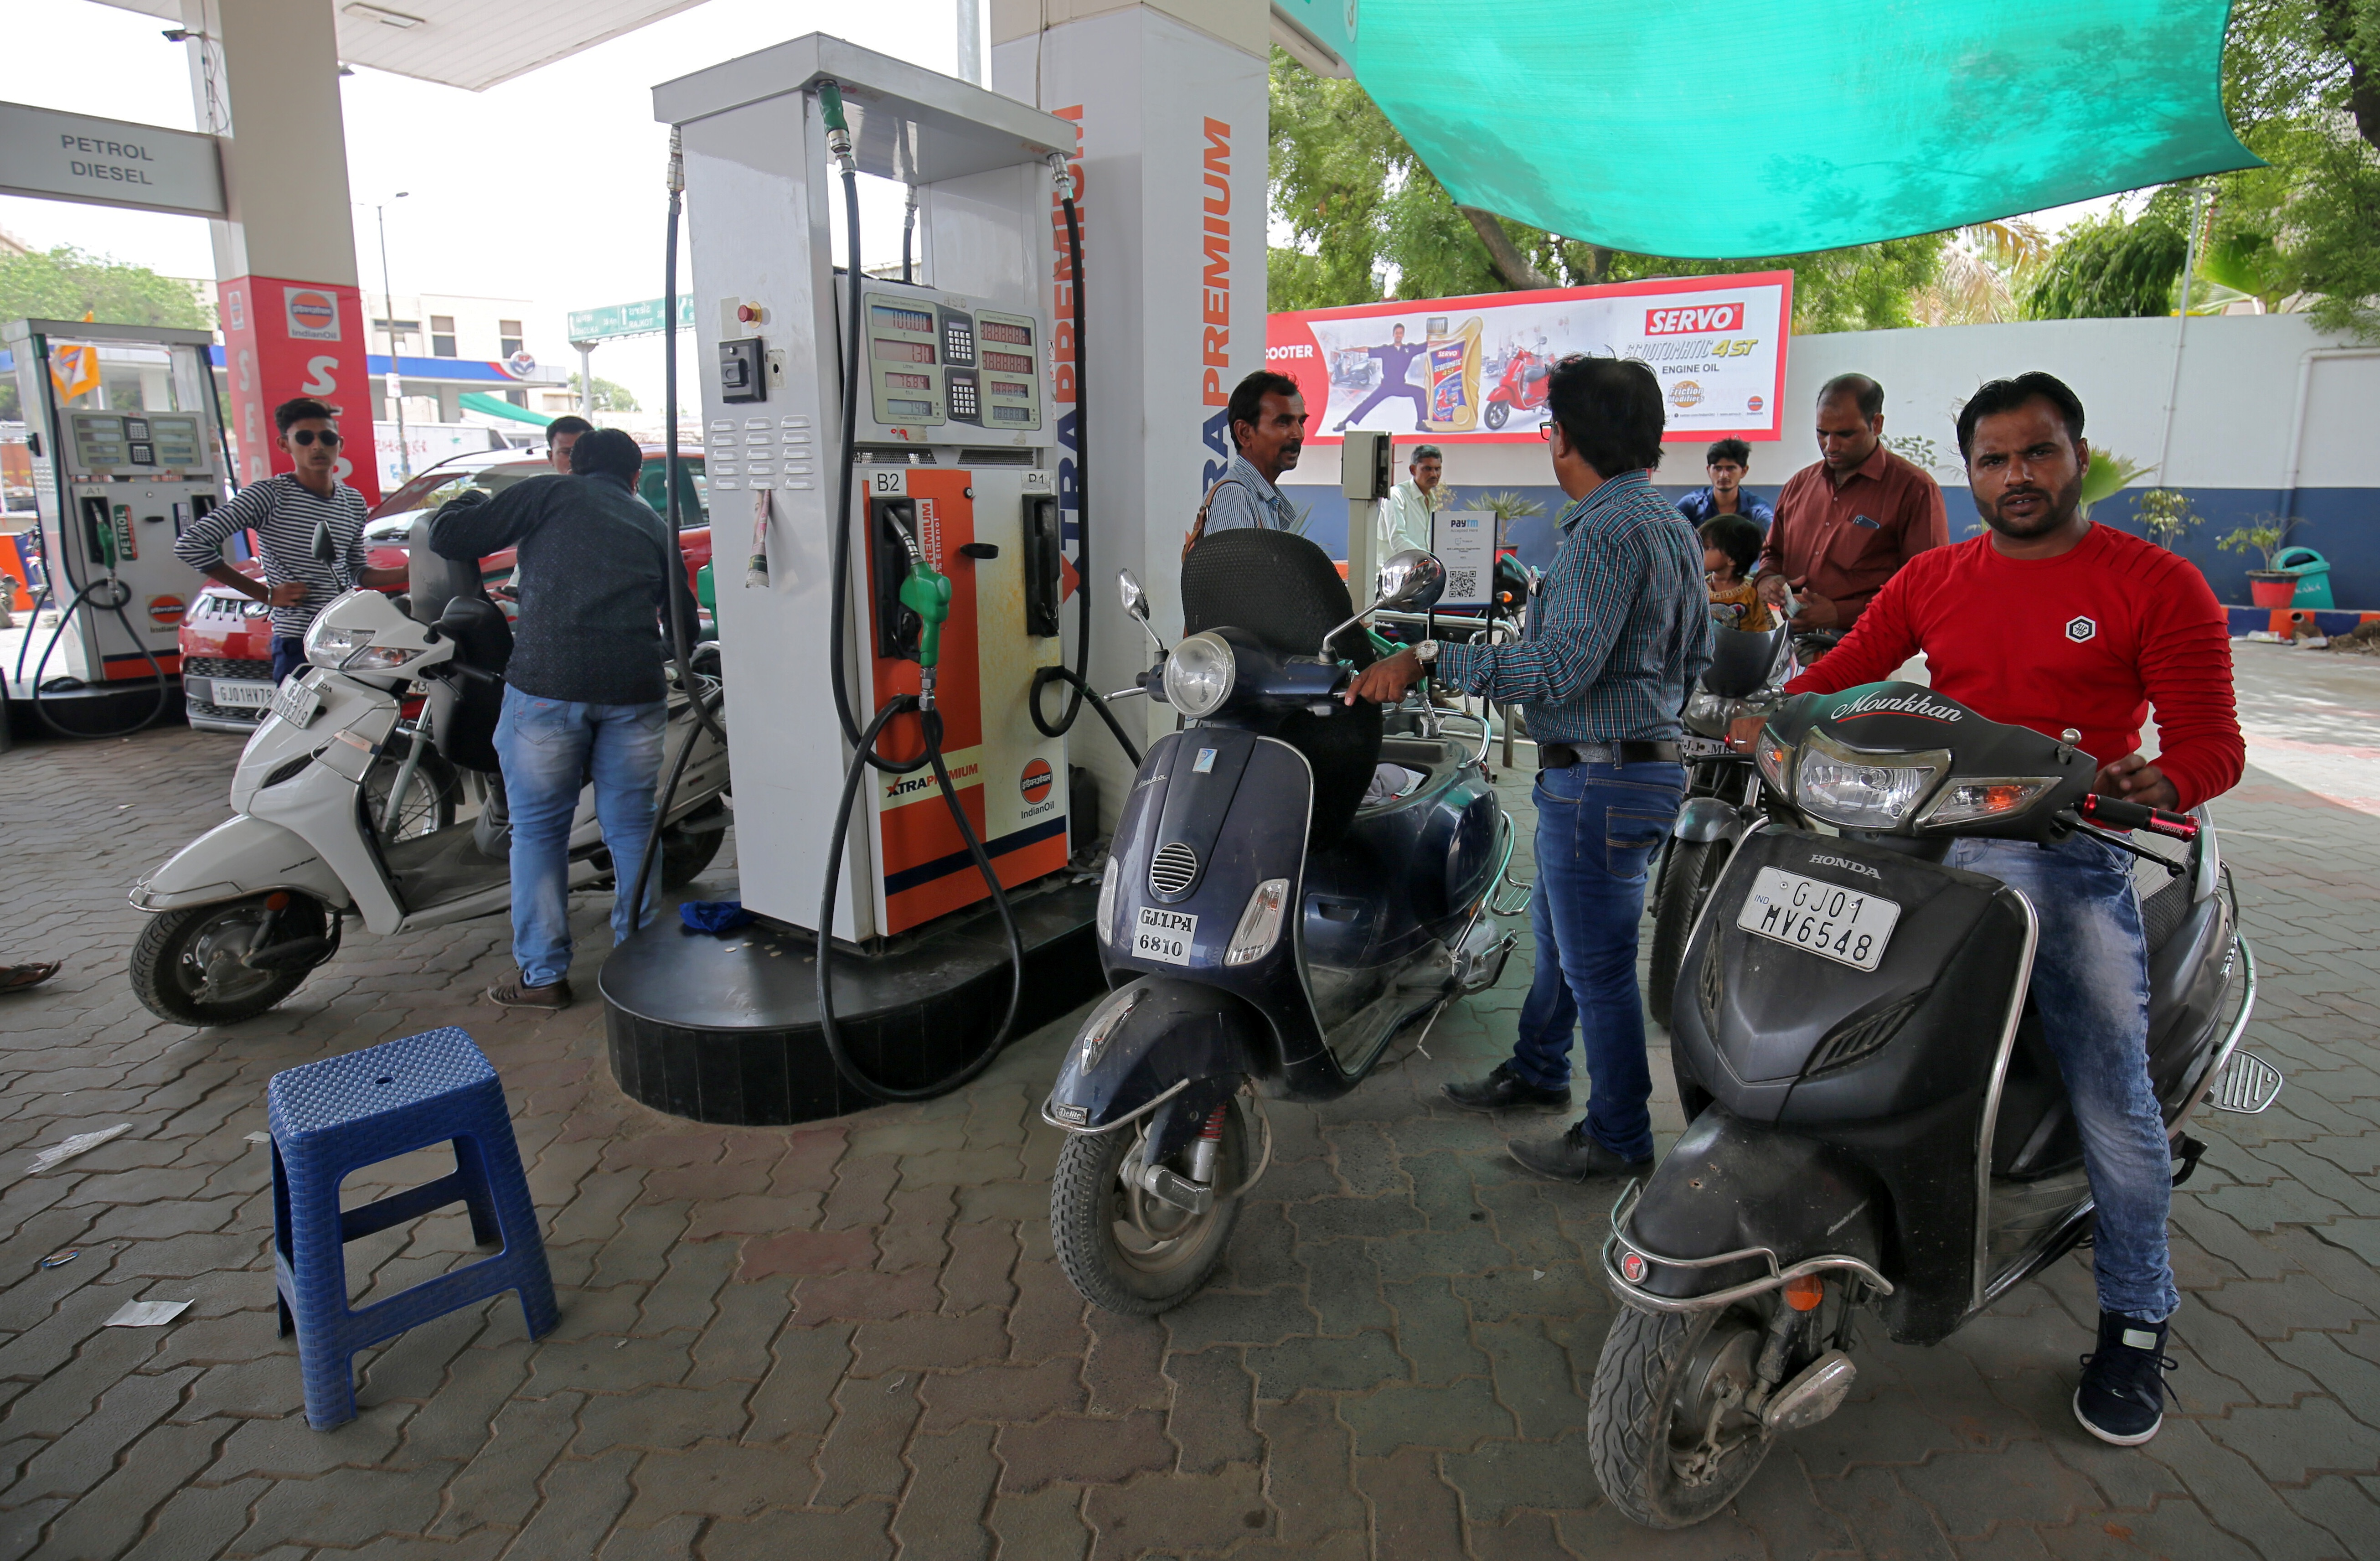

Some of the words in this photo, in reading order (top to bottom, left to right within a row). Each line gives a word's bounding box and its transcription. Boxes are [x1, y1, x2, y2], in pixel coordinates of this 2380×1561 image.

[61, 134, 154, 161] PETROL
[71, 161, 153, 185] DIESEL
[1649, 306, 1734, 333] SERVO
[1265, 344, 1313, 360] OOTER
[1662, 364, 1700, 374] ENGINE
[1703, 363, 1720, 372] OIL
[1668, 394, 1704, 403] Modifiers
[1669, 387, 1704, 395] Friction
[878, 473, 899, 491] B2
[116, 511, 132, 554] PETROL
[922, 503, 934, 572] REMIUM
[887, 763, 978, 798] XTRAPMIUM
[1021, 801, 1054, 819] IndianOil
[1809, 854, 1882, 879] HONDA
[1754, 894, 1770, 905] IND
[1792, 882, 1864, 924] GJ01
[1140, 934, 1183, 956] 6810
[1760, 905, 1872, 961] MV6548
